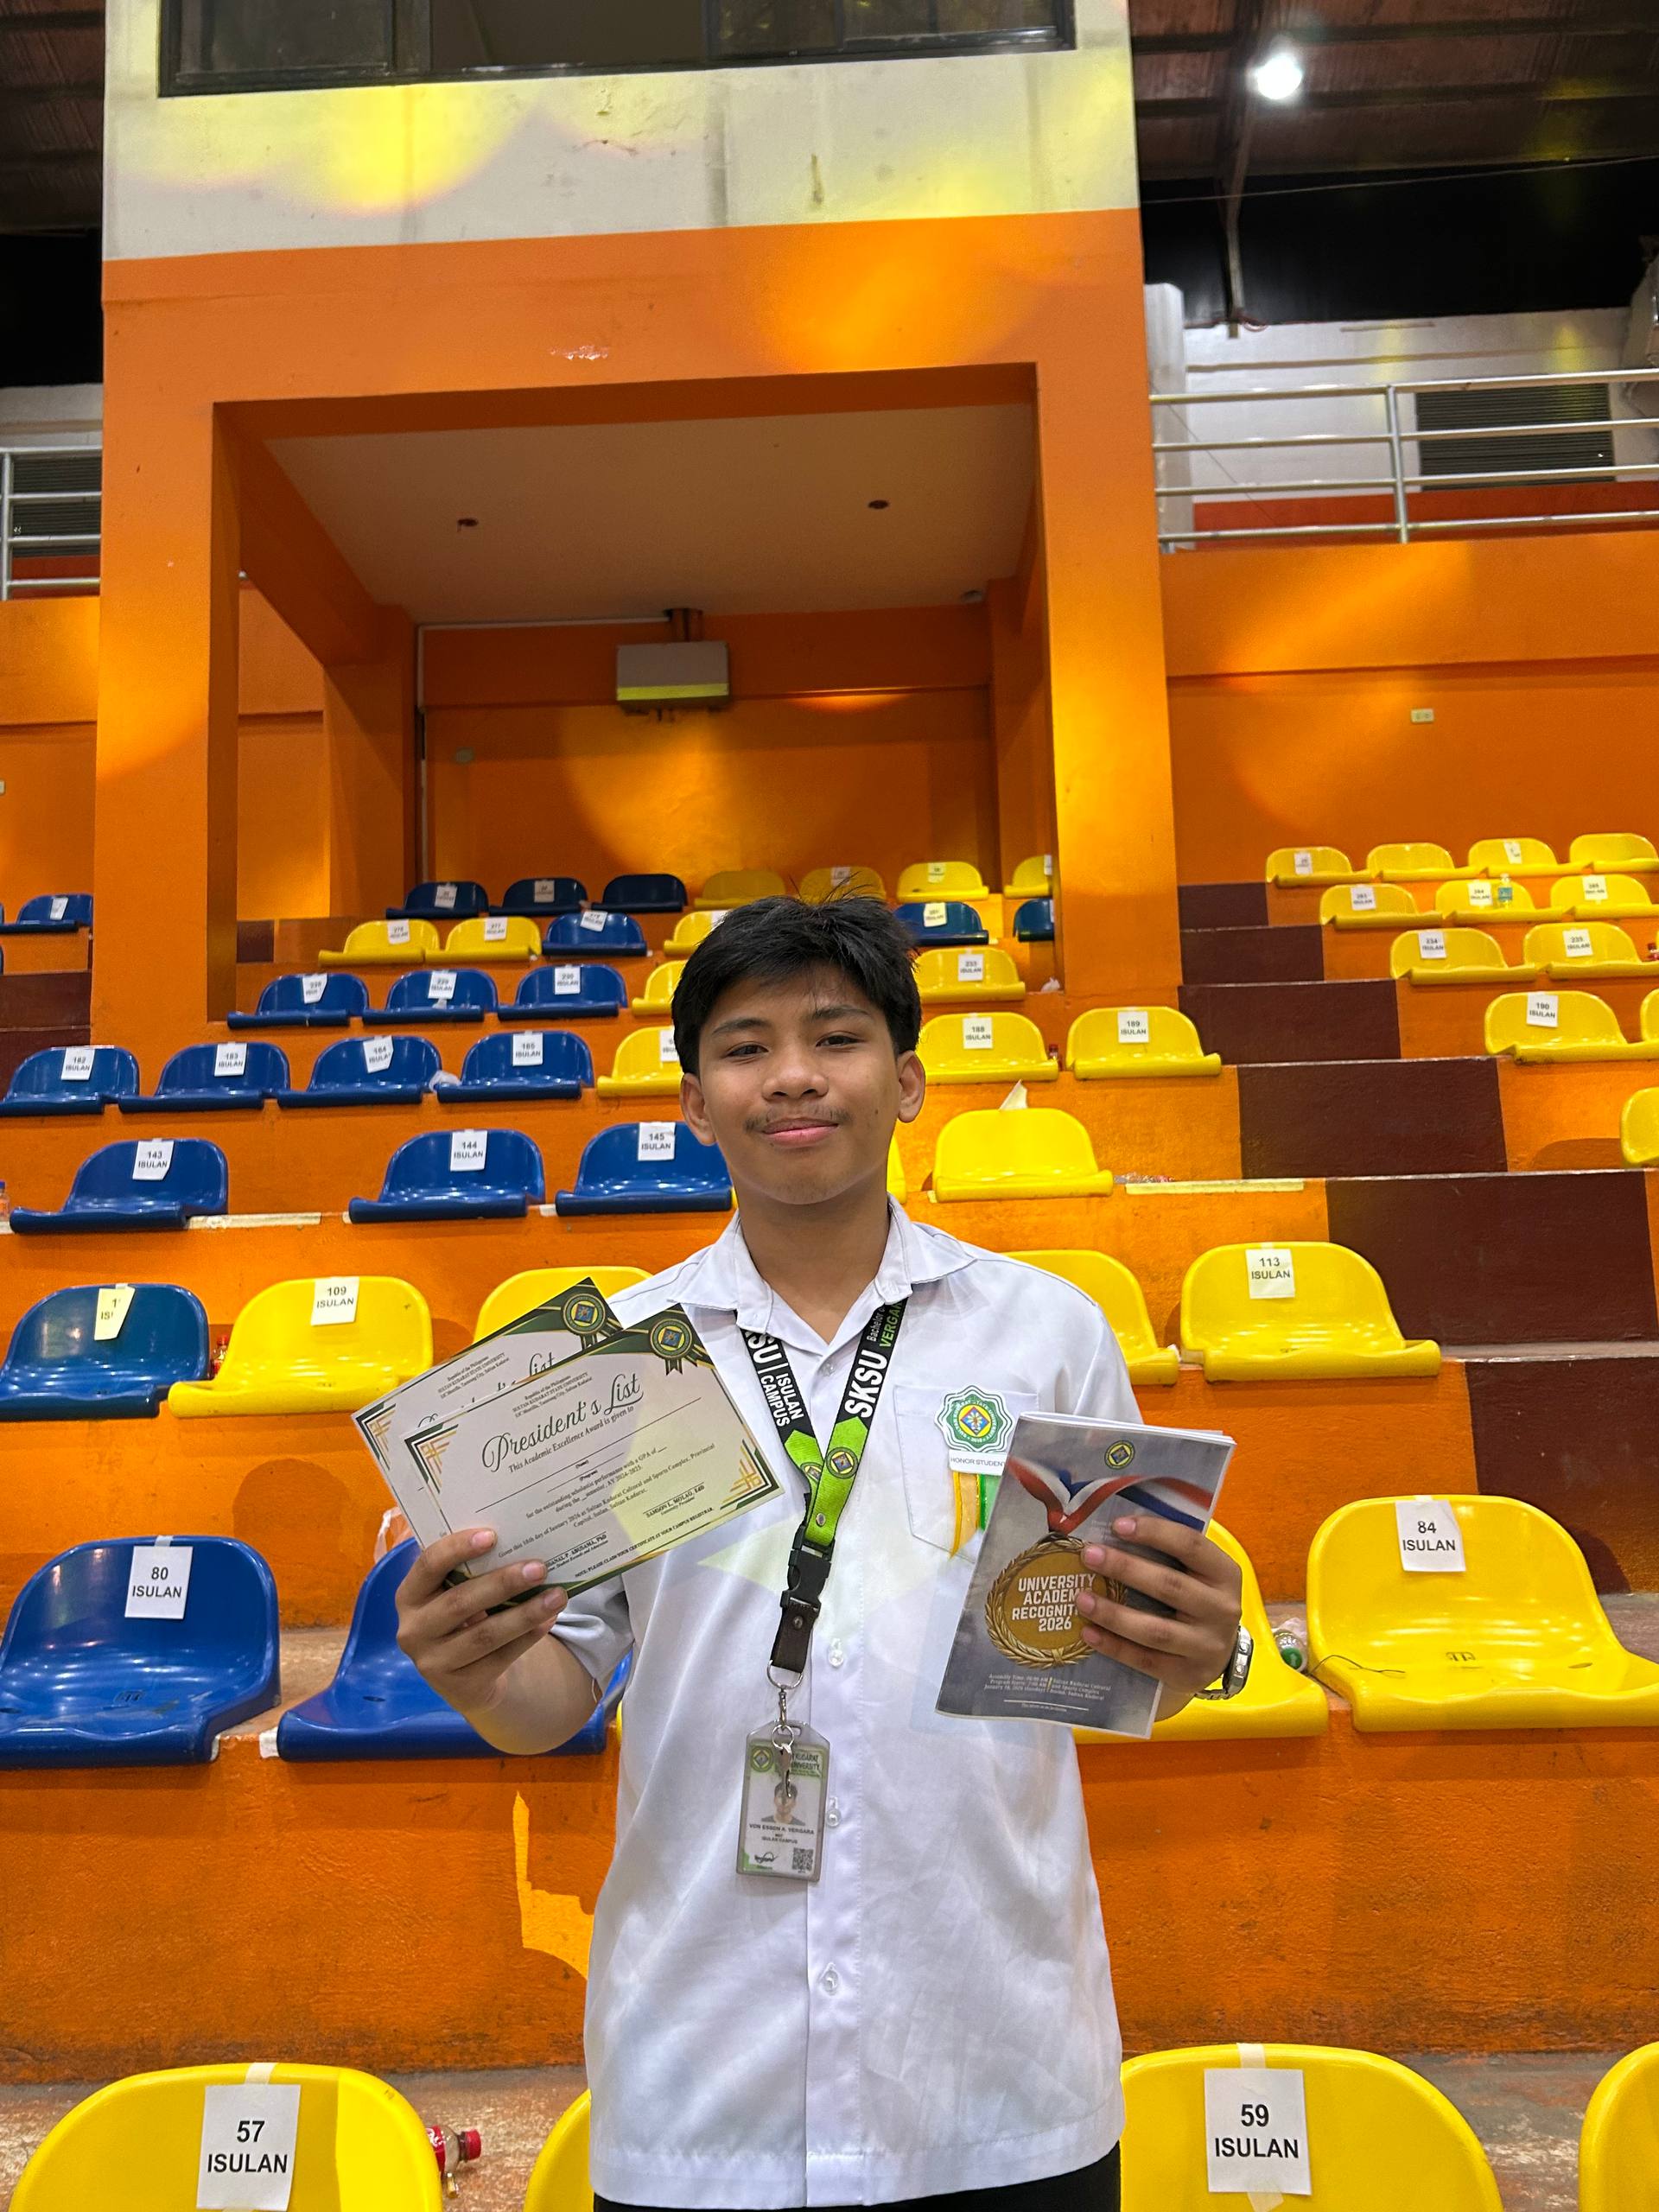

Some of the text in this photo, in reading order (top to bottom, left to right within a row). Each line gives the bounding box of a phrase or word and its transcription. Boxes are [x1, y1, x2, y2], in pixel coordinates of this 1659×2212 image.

[1529, 1009, 1556, 1019] ISULAN
[218, 1059, 244, 1068] ISULAN
[454, 1150, 483, 1160] ISULAN
[137, 1160, 168, 1168] ISULAN
[1259, 1257, 1280, 1267] 113
[1251, 1269, 1291, 1280] ISULAN
[327, 1286, 346, 1296] 109
[316, 1297, 354, 1308] ISULAN
[866, 1312, 883, 1342] Bachelor
[844, 1350, 887, 1418] SKSU
[760, 1375, 791, 1427] CAMPUS
[776, 1373, 804, 1420] ISULAN
[481, 1399, 607, 1472] President's
[599, 1372, 644, 1415] List
[507, 1402, 633, 1472] This Academic Excellence Award is given to
[637, 1451, 651, 1461] GPA
[1417, 1521, 1436, 1534] 84
[1402, 1539, 1456, 1551] ISULAN
[151, 1567, 168, 1580] 80
[1018, 1573, 1096, 1592] UNIVERSITY
[132, 1585, 182, 1599] ISULAN
[1023, 1588, 1081, 1605] ACADEM
[1012, 1604, 1077, 1621] RECOGNIT
[1039, 1616, 1072, 1631] 2026
[1241, 2104, 1269, 2127] 59
[237, 2120, 265, 2143] 57
[1215, 2138, 1299, 2158] ISULAN
[207, 2153, 288, 2173] ISULAN
